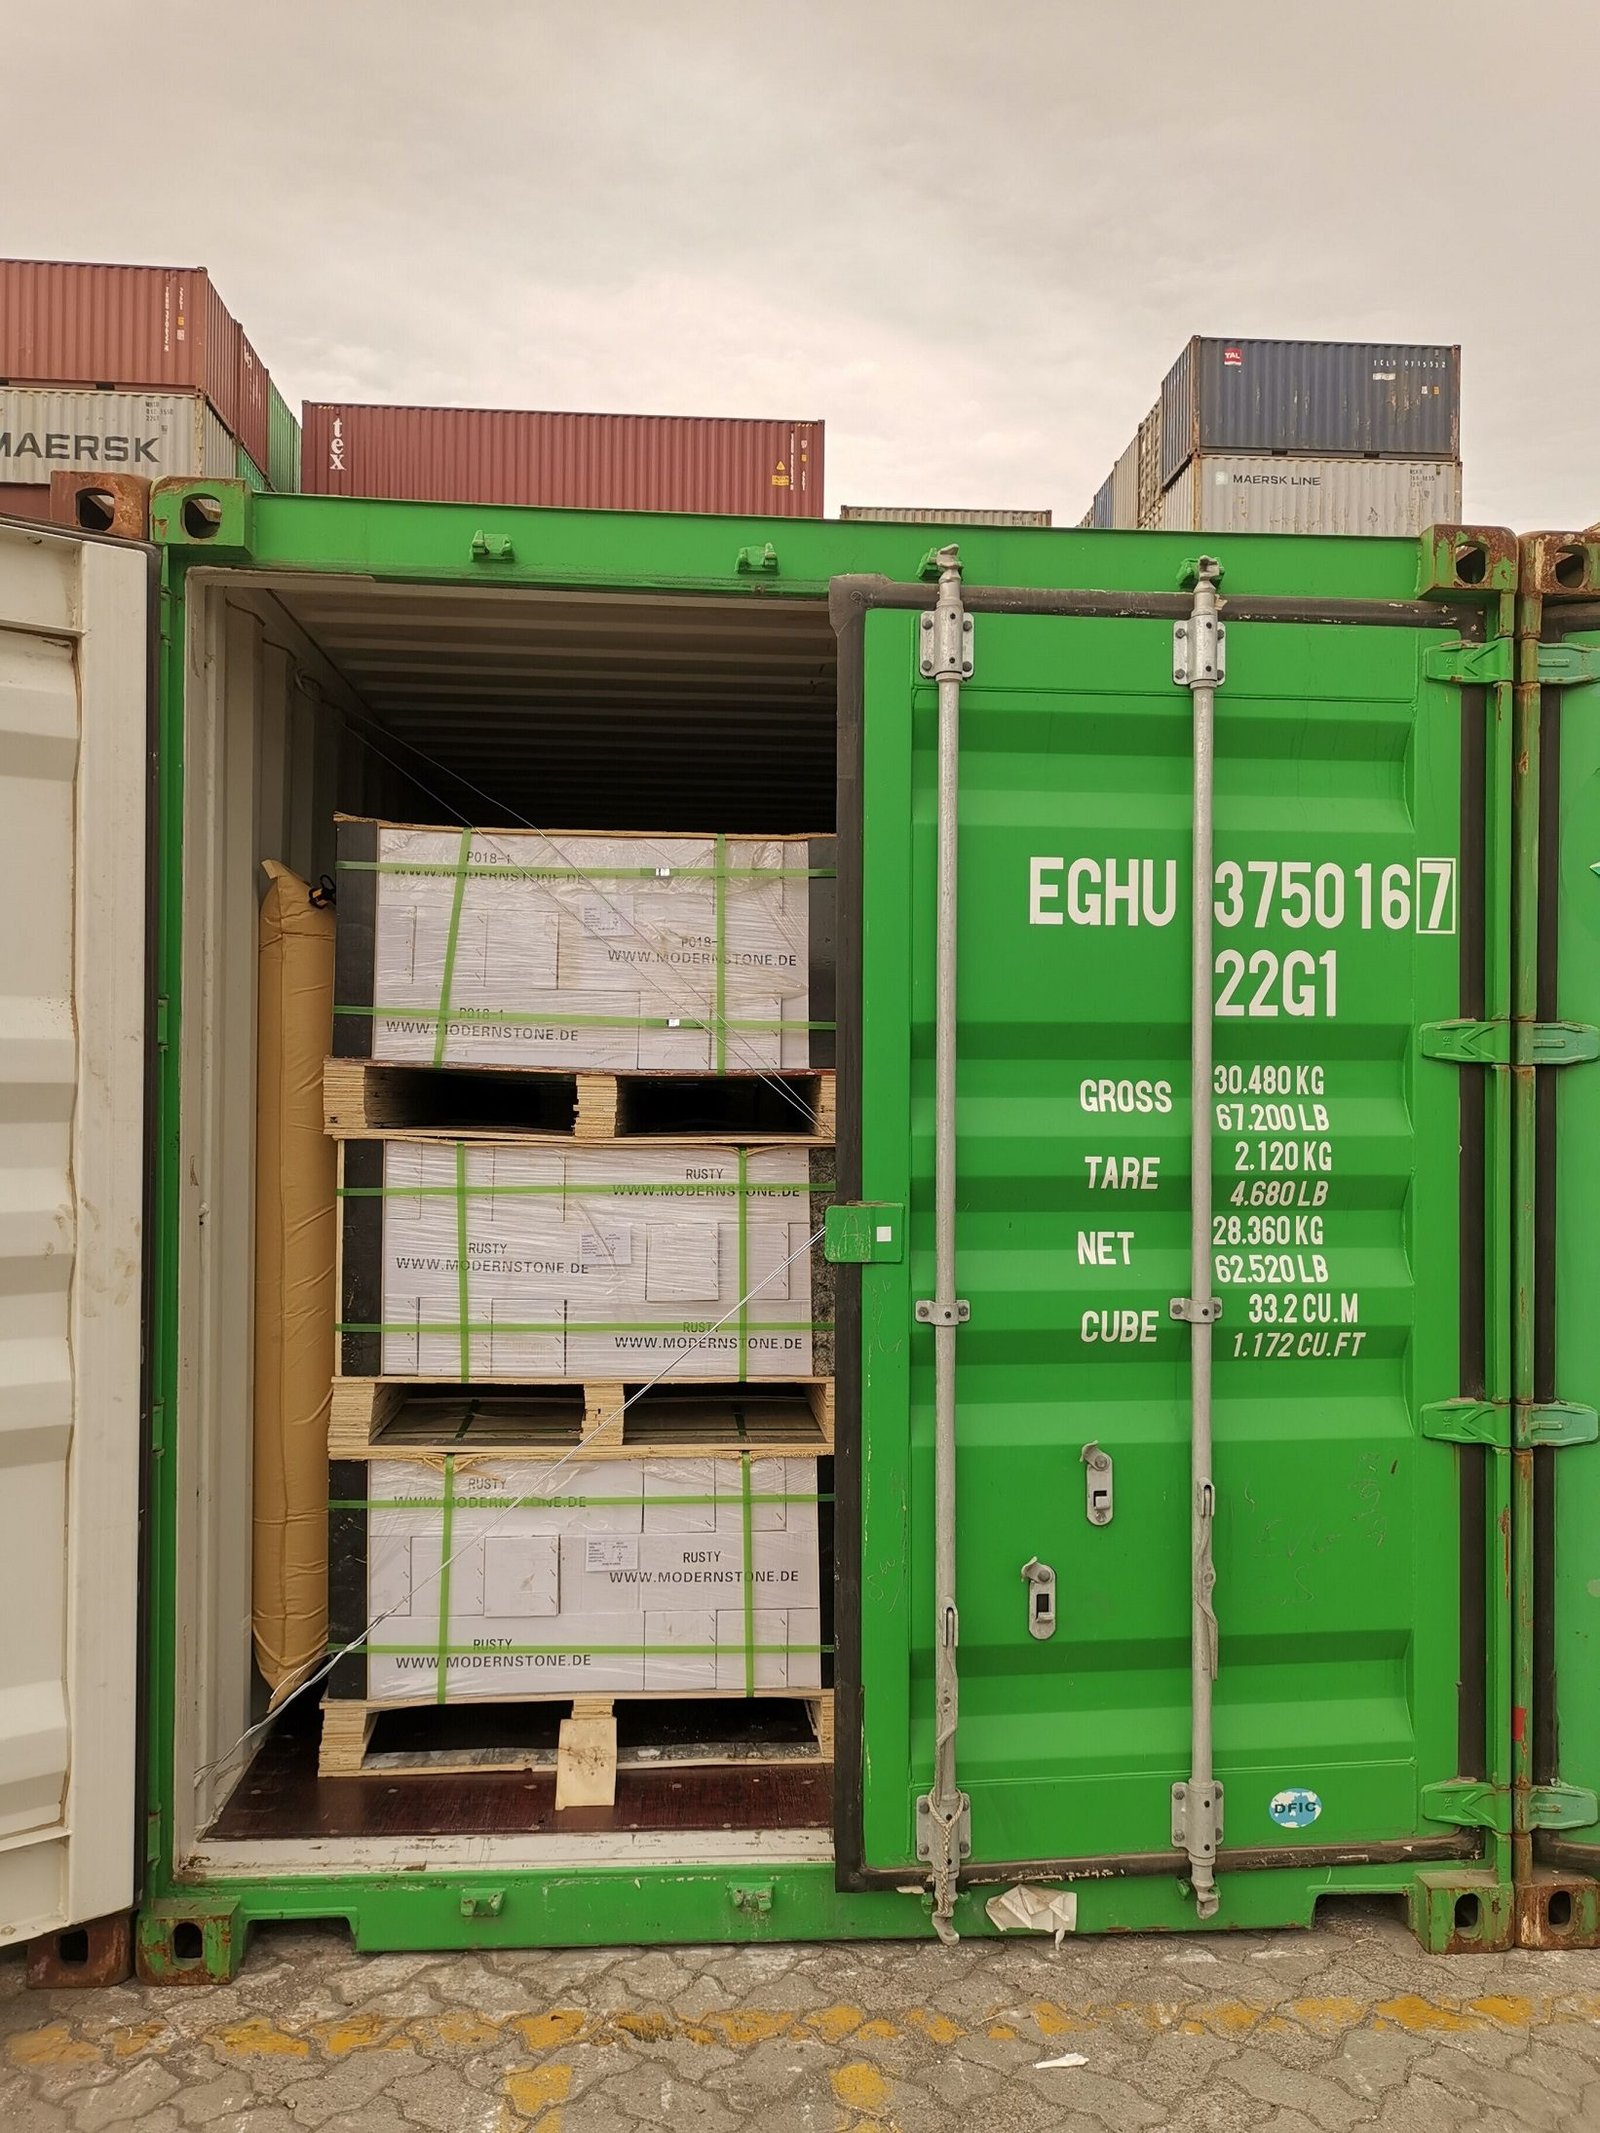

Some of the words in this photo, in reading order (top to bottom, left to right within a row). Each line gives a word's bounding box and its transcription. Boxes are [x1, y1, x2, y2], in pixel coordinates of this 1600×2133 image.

[330, 417, 347, 471] tex
[1233, 474, 1287, 485] MAERSK
[1291, 476, 1321, 486] LINE
[1029, 856, 1177, 927] EGHU
[1421, 862, 1452, 929] 7
[681, 936, 722, 948] P018-
[1214, 948, 1337, 1017] 22G1
[1296, 1065, 1324, 1095] KG
[1080, 1079, 1173, 1113] GROSS
[1298, 1103, 1330, 1132] LB
[1303, 1141, 1332, 1171] KG
[685, 1168, 724, 1180] RUSTY
[1084, 1156, 1161, 1190] TARE
[612, 1184, 800, 1197] WWW.MODERNSONE.DE
[1297, 1180, 1329, 1206] LB
[1295, 1215, 1323, 1245] KG
[468, 1242, 508, 1255] RUSTY
[1077, 1231, 1135, 1265] NET
[396, 1257, 590, 1275] WWW.MODERNSTONE.DE
[1298, 1254, 1329, 1283] LB
[1248, 1293, 1298, 1324] 33.2
[1302, 1293, 1358, 1323] CU.M
[1081, 1310, 1159, 1343] CUBE
[1296, 1332, 1367, 1357] CU.FT
[468, 1478, 507, 1490] RUSTY
[683, 1551, 721, 1563] RUSTY
[609, 1570, 800, 1584] WWW.MODERNSTONE.DE
[473, 1639, 513, 1650] RUSTY
[395, 1655, 591, 1669] WWWMODERNSTONE.DE
[1274, 1801, 1316, 1814] DFIC
